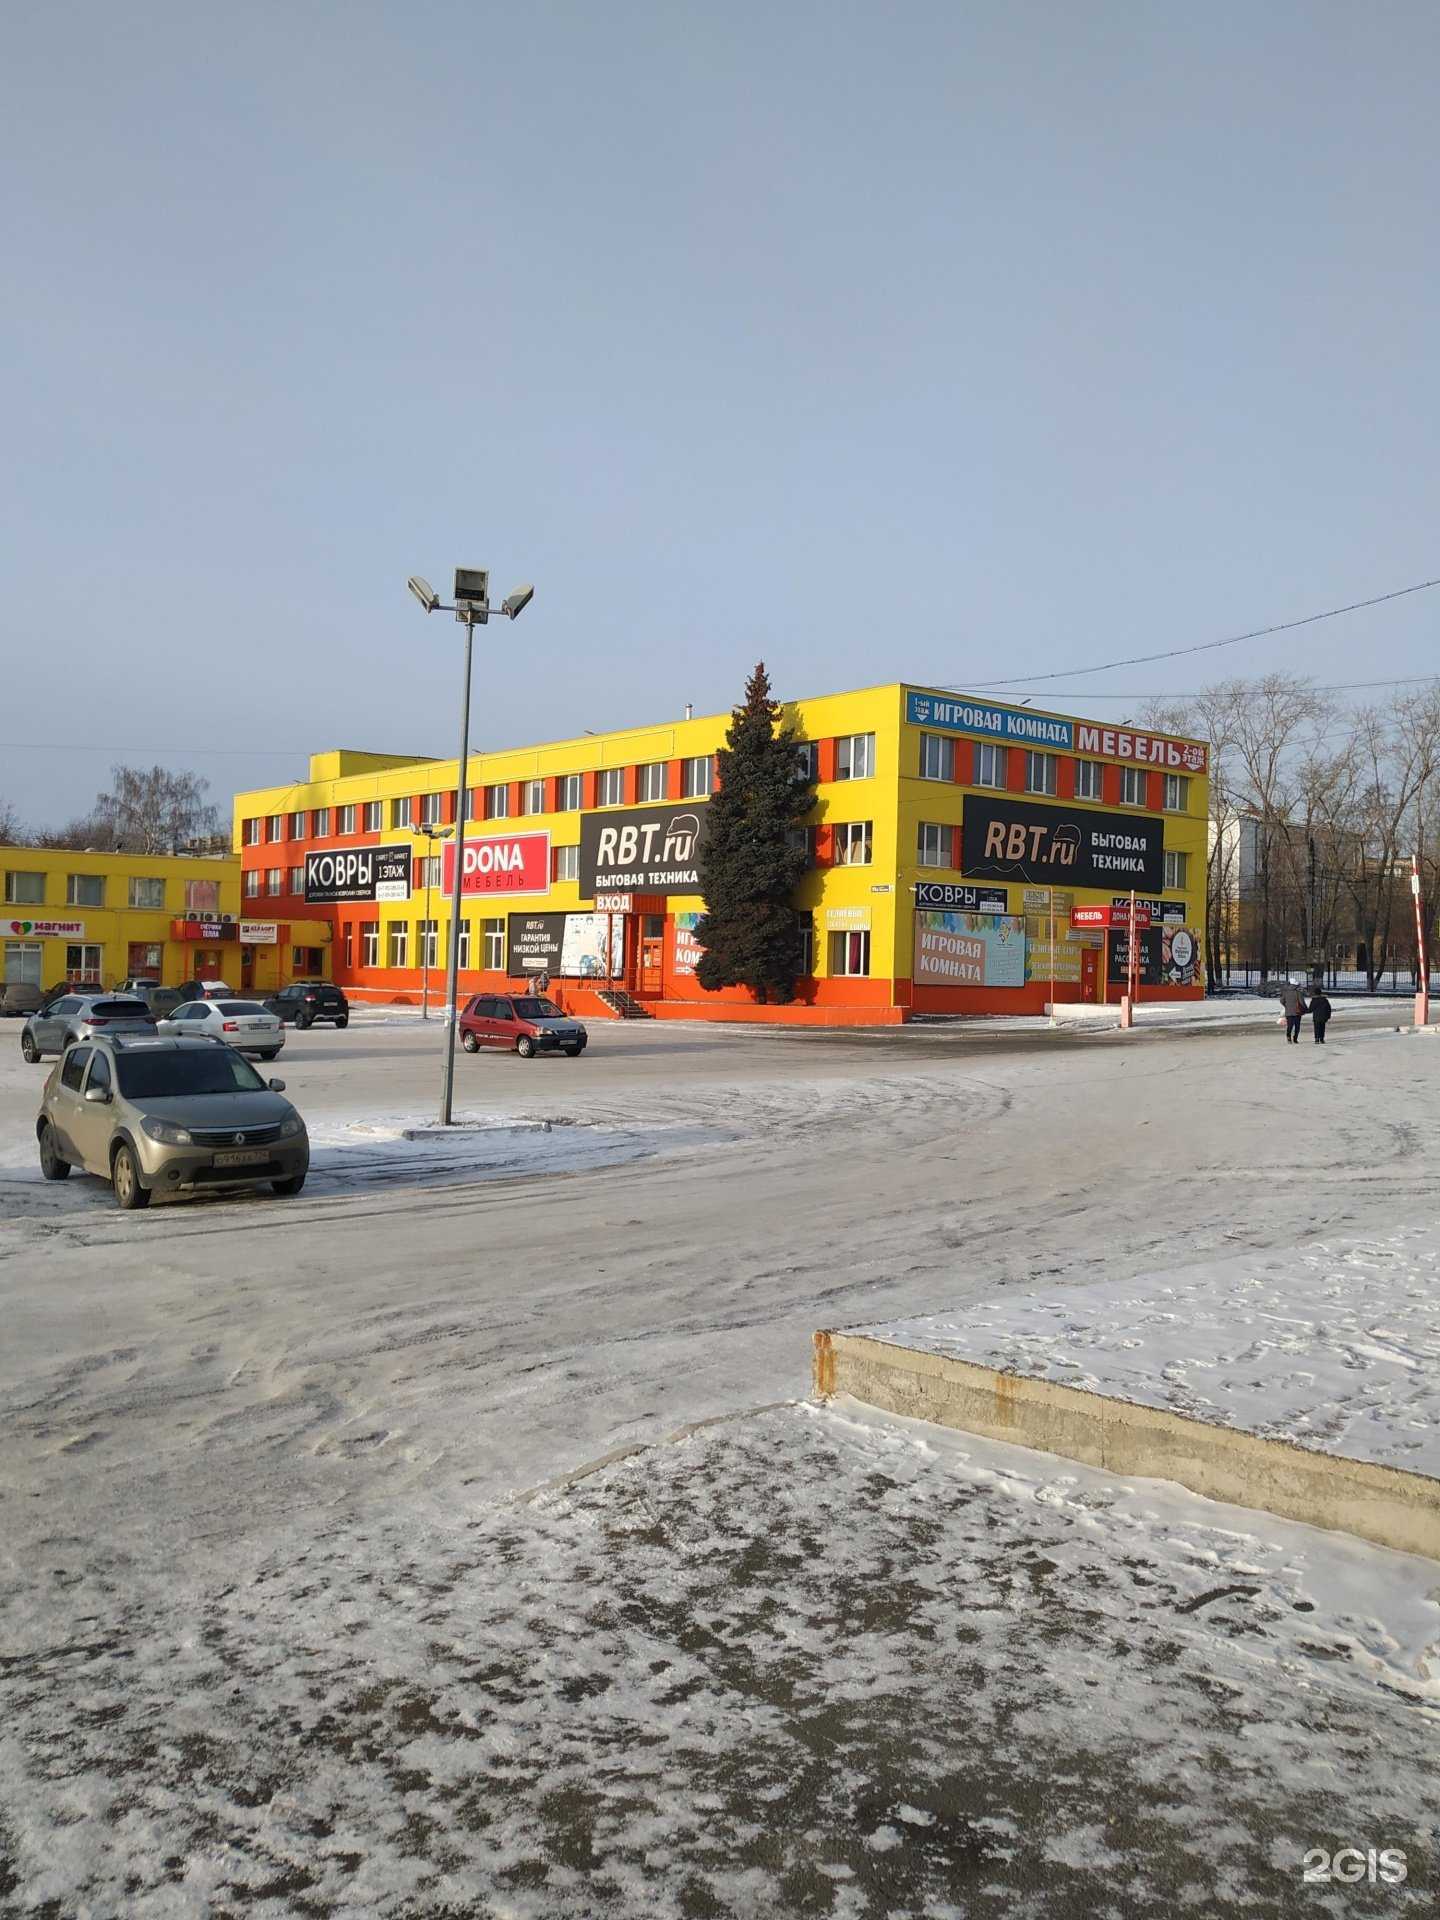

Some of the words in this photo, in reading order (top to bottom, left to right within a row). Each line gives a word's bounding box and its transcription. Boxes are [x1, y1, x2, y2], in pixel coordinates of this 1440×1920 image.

[933, 702, 1002, 731] ИГРОВАЯ
[1007, 715, 1069, 744] КОМНАТА
[1078, 726, 1181, 766] МЕБЕЛЬ
[596, 822, 692, 866] RBT.ru
[984, 821, 1075, 865] RBT.ru
[1091, 832, 1147, 851] БЫТОВАЯ
[463, 843, 524, 874] DONA
[1092, 854, 1145, 873] ТЕХНИКА
[308, 853, 373, 887] КОВРЫ
[382, 865, 405, 879] ЭТАЖ
[596, 873, 644, 887] БЫТОВАЯ
[648, 870, 699, 884] ТЕХНИКА
[463, 874, 524, 889] МЕБЕЛЬ
[596, 894, 630, 911] ВХОД
[918, 884, 977, 904] КОВРЫ
[1074, 911, 1103, 921] МЕБЕЛЬ
[521, 933, 551, 943] ГАРАНТИЯ
[921, 933, 981, 959] ИГРОВАЯ
[513, 943, 540, 954] НИЗКОЙ
[540, 942, 558, 954] ЦЕНЫ
[920, 955, 981, 981] КОМНАТА
